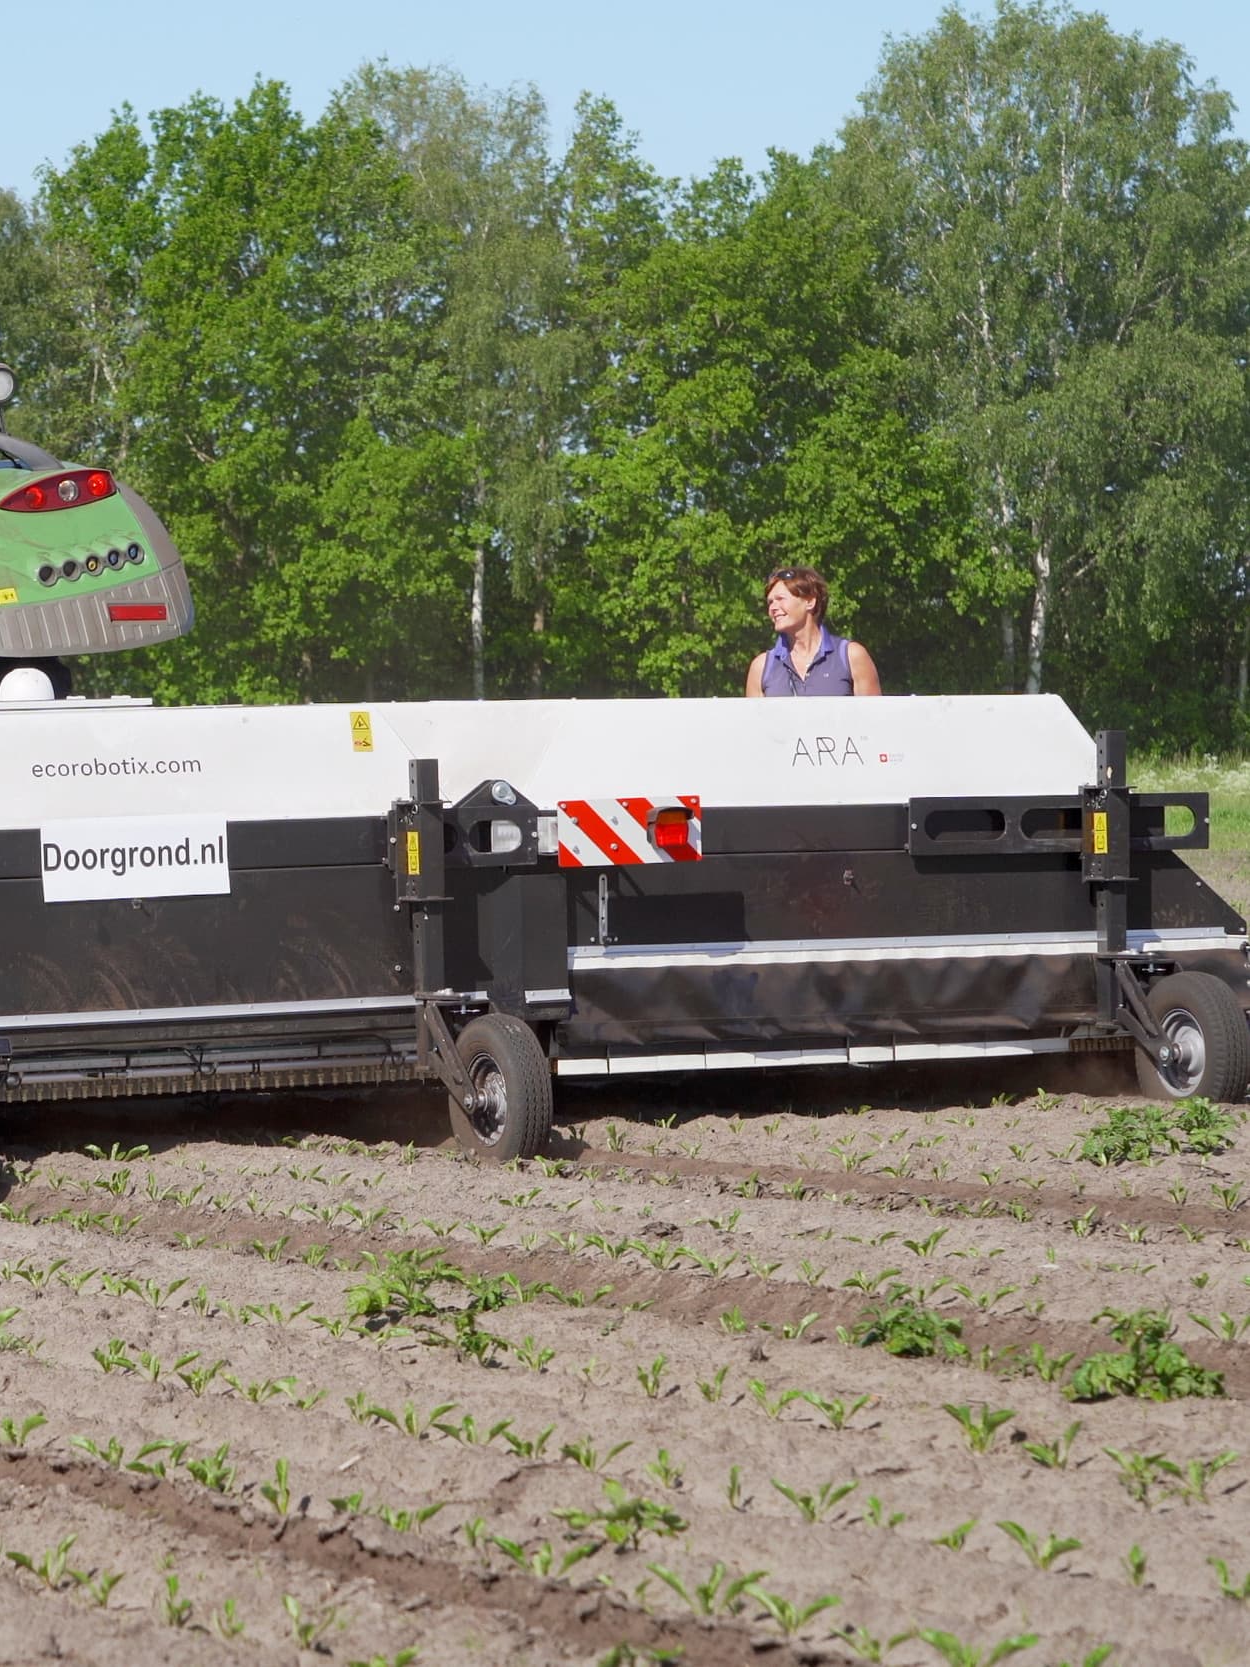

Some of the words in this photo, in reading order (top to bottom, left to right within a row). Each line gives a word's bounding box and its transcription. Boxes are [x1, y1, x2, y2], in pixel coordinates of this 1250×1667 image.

[31, 757, 202, 777] ecorobotix.com
[791, 736, 865, 767] ARA
[43, 835, 225, 876] Doorgrond.nl
